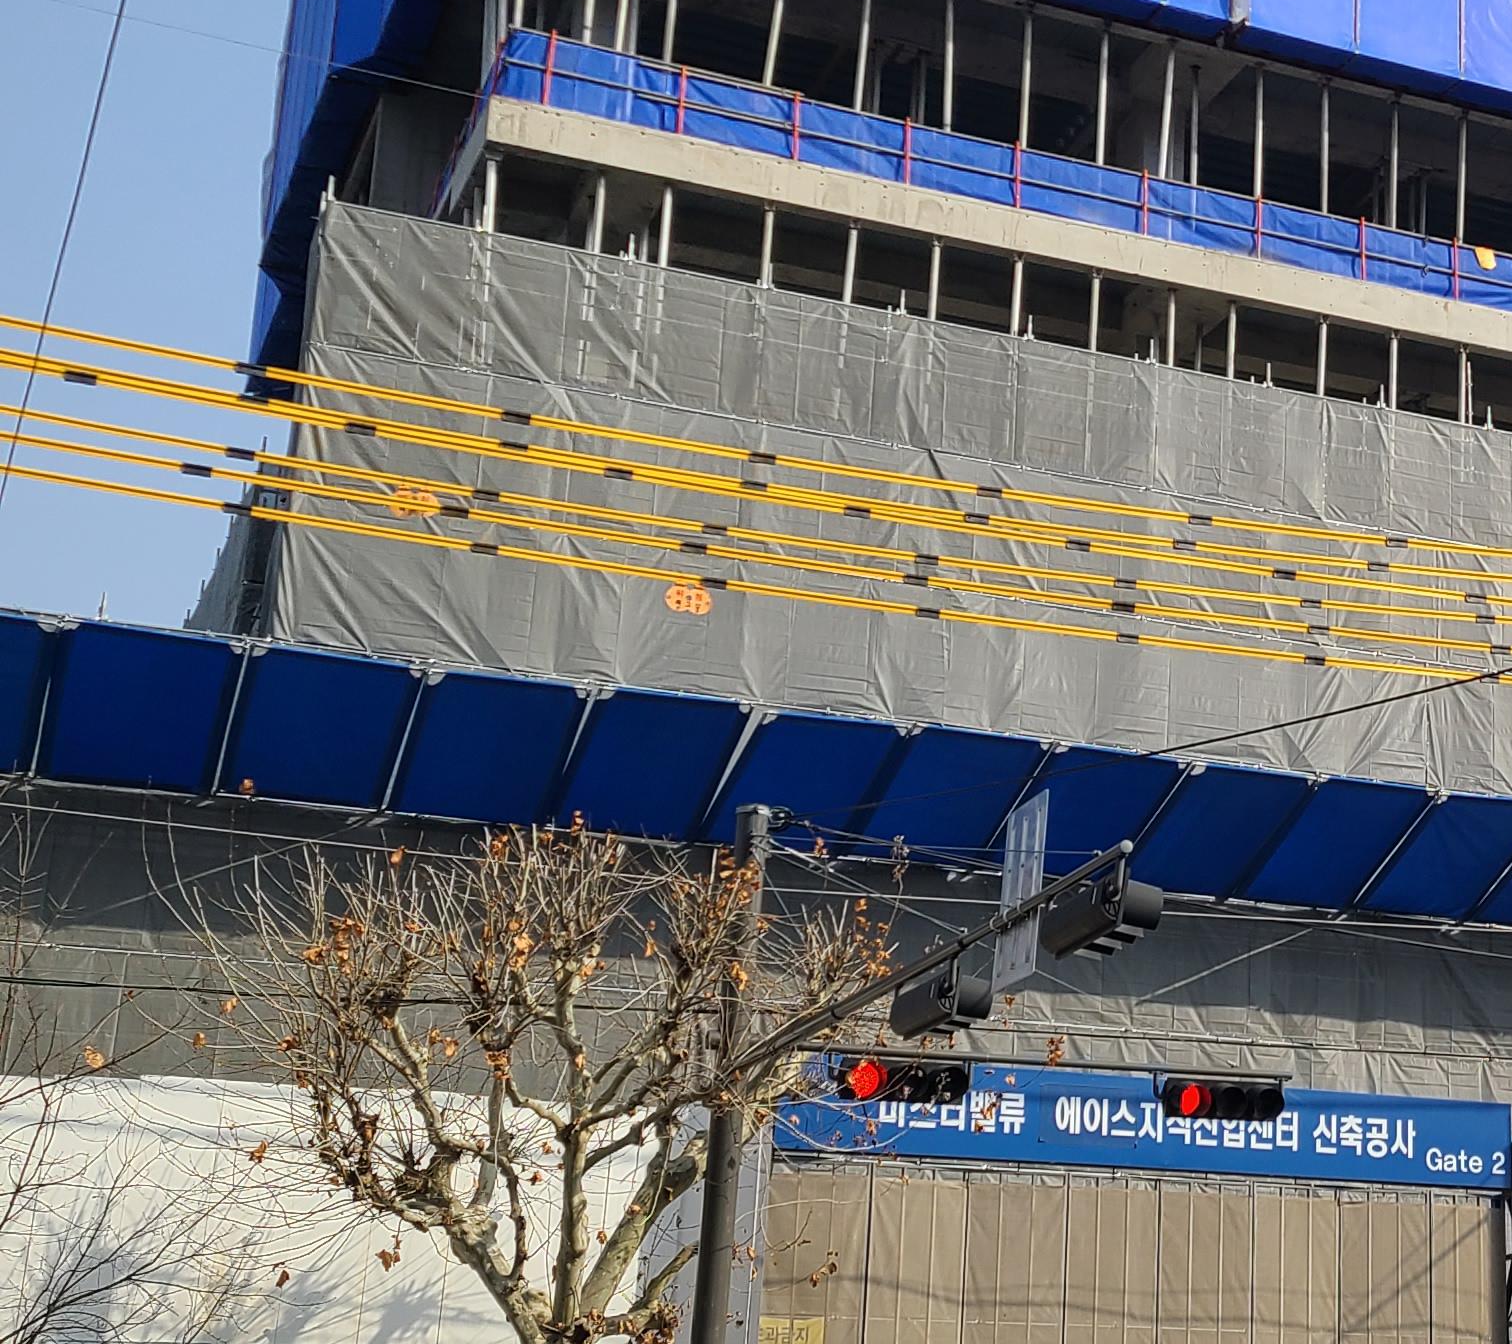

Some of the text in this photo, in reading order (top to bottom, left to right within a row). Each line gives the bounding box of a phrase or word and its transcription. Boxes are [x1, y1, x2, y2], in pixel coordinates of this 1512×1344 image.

[1312, 1113, 1416, 1159] 신축공사
[1425, 1147, 1506, 1175] Gate 2
